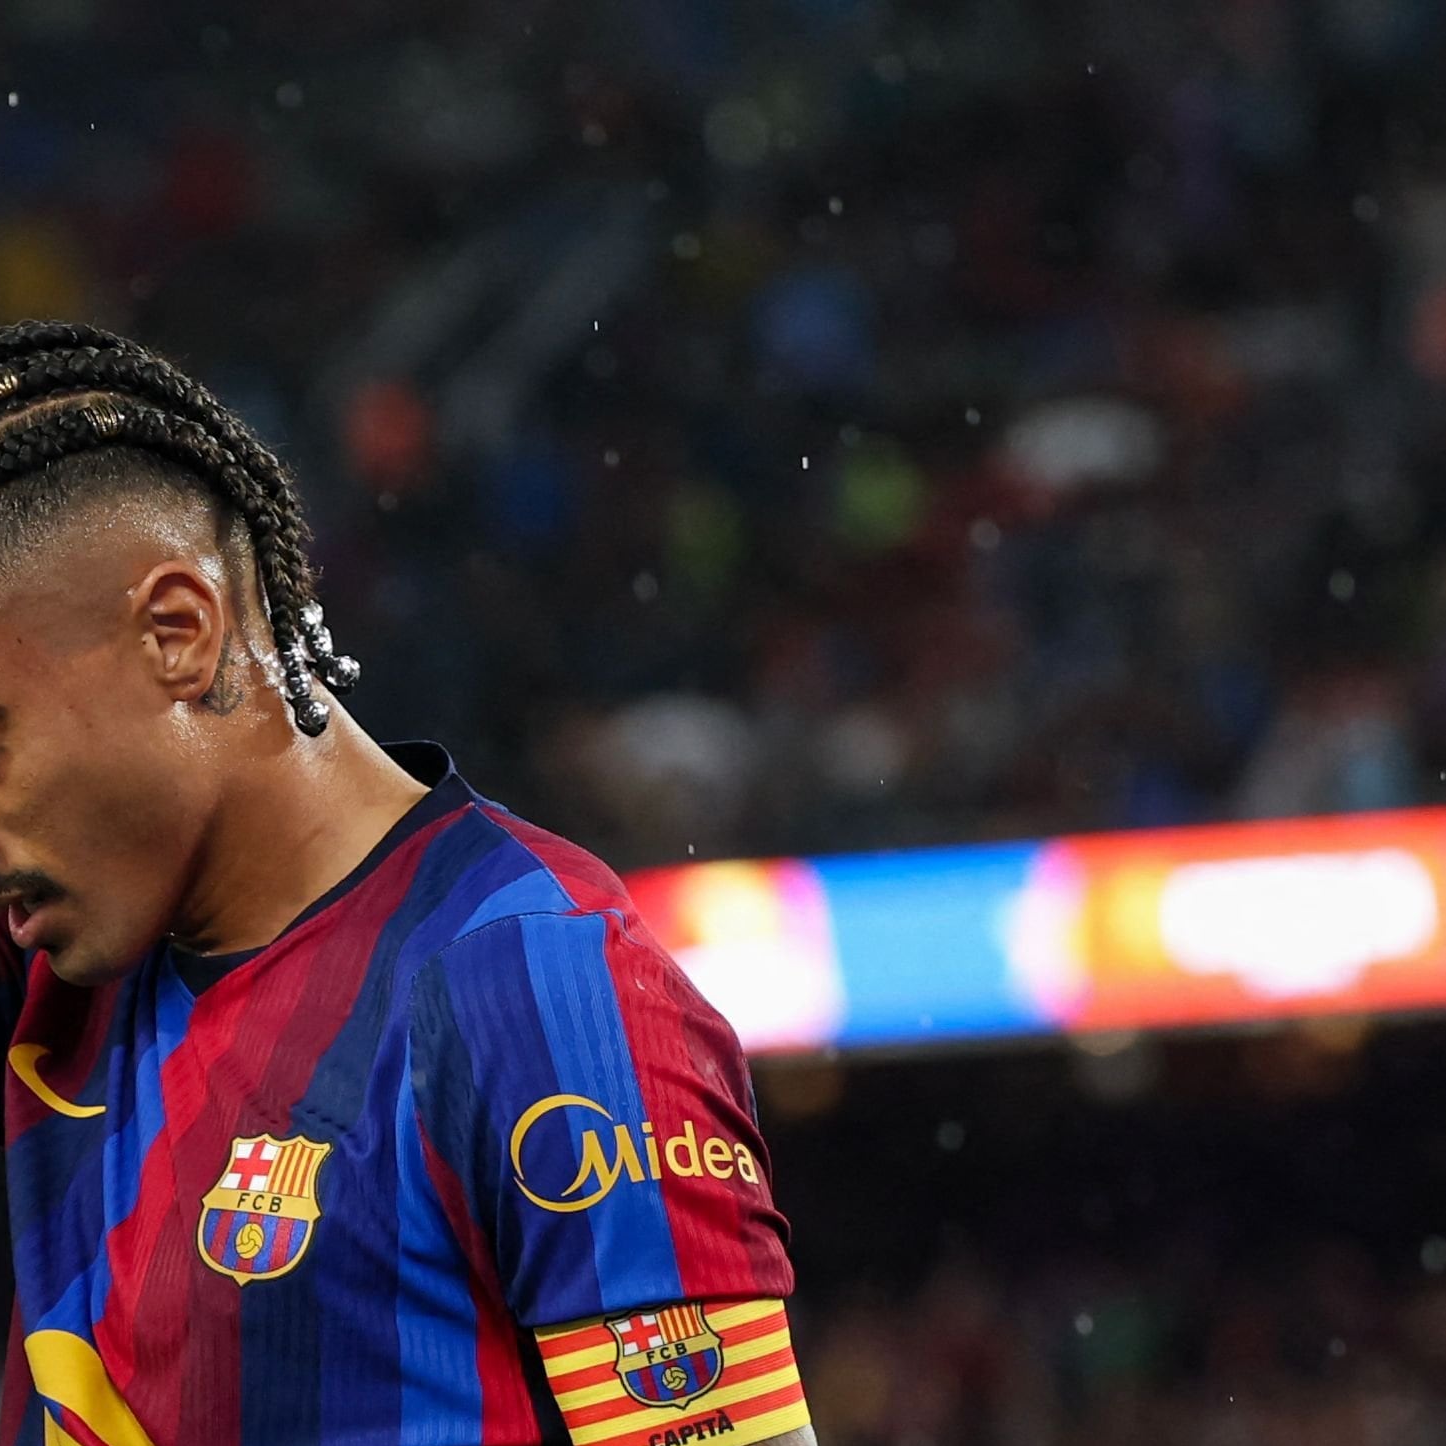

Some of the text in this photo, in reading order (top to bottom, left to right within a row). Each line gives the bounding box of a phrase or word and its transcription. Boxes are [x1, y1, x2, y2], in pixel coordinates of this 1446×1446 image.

[558, 1119, 760, 1200] Midea
[236, 1192, 283, 1213] FCB
[645, 1342, 688, 1365] FCB
